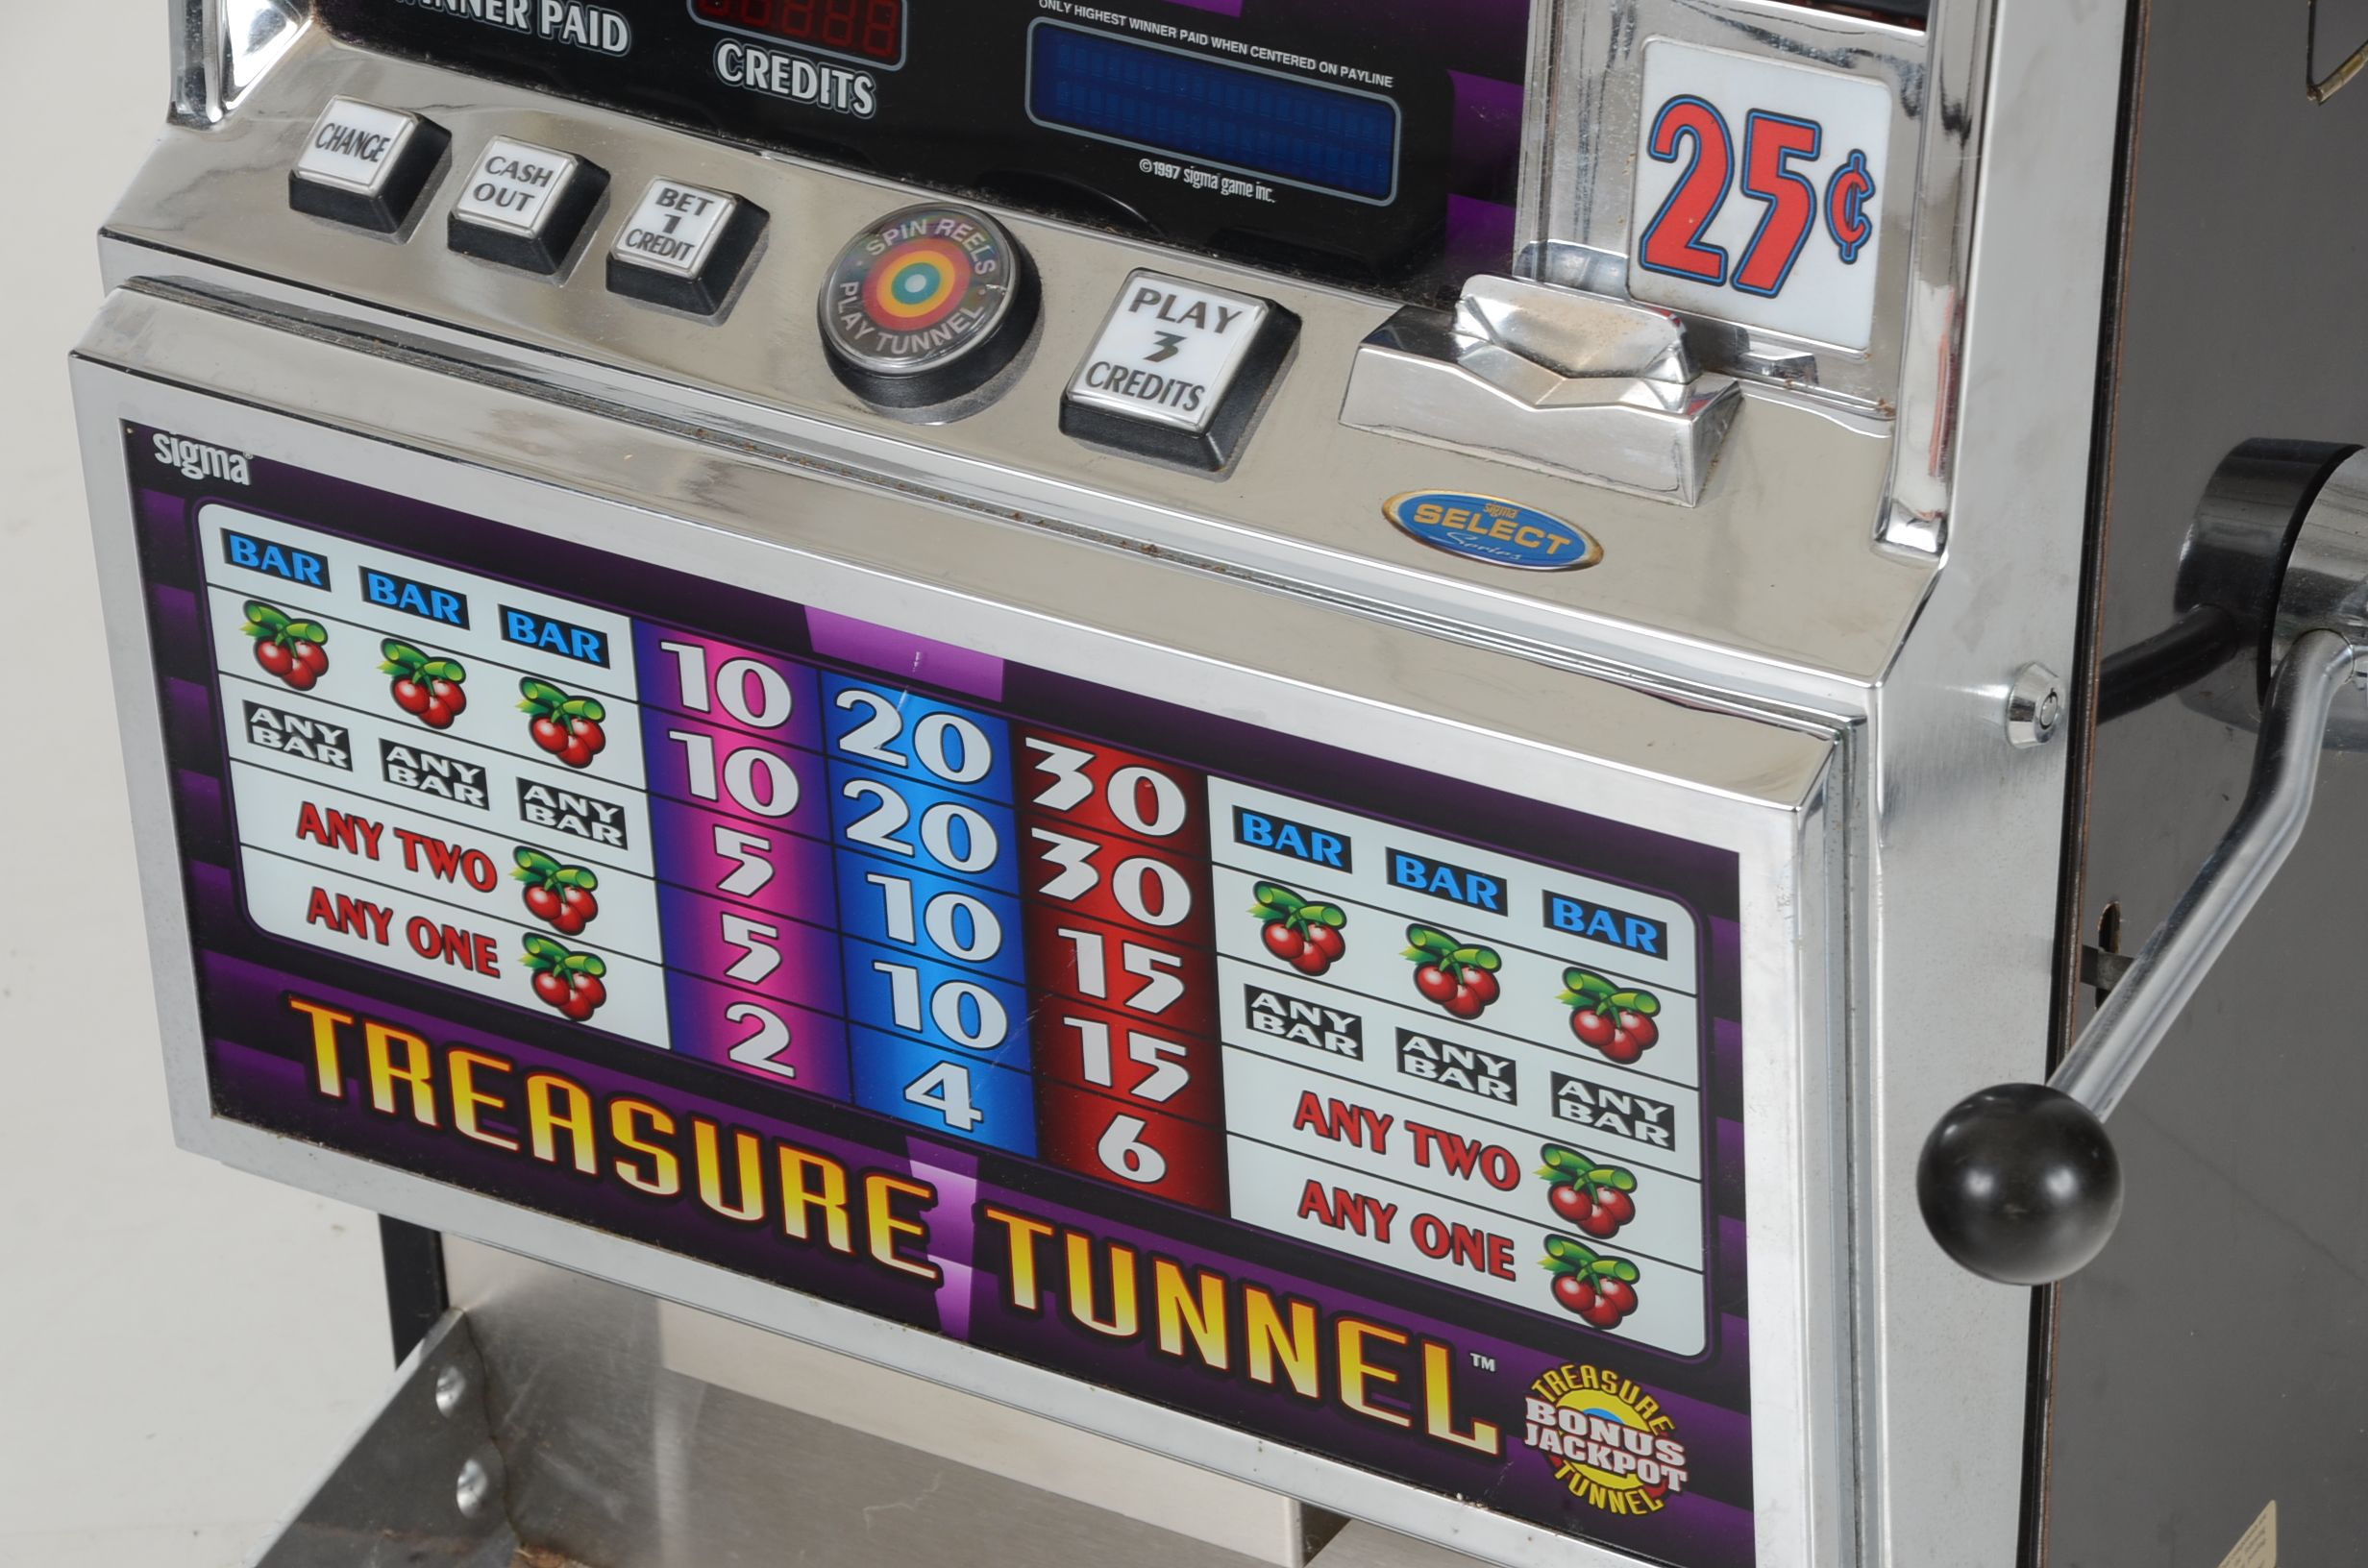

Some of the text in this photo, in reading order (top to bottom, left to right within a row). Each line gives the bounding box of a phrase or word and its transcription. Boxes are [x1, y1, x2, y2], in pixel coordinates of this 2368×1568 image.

[399, 0, 629, 52] NER PAID
[1039, 0, 1394, 88] ONLY HIGHEST WINNER PAID WHEN CENTERED ON PAYLINE
[716, 41, 874, 115] CREDITS
[314, 123, 391, 162] CHANGE
[472, 182, 536, 212] OUT
[484, 156, 554, 187] CASH
[1183, 166, 1220, 189] sigma
[1221, 176, 1253, 198] game
[1255, 182, 1276, 204] inc.
[655, 188, 714, 216] BET
[665, 213, 679, 233] 1
[625, 228, 695, 261] CREDIT
[867, 218, 996, 277] SPIN REELS
[840, 281, 985, 355] PLAY TUNNEL
[1128, 286, 1243, 334] PLAY
[1143, 330, 1185, 361] 3
[1085, 361, 1206, 412] CREDITS
[1414, 503, 1571, 554] SELECT
[1429, 531, 1521, 560] Series
[230, 534, 601, 663] BAR BAR BAR
[250, 708, 343, 746] ANY
[252, 725, 349, 769] BAR
[660, 641, 1187, 836] 10 20 30
[386, 747, 481, 784] ANY
[387, 764, 484, 807] BAR
[523, 785, 619, 823] ANY
[525, 802, 623, 846] BAR
[668, 729, 1192, 927] 10 20 30
[297, 801, 498, 893] ANY TWO
[1242, 812, 1658, 954] BAR BAR BAR
[307, 887, 500, 978] ANY ONE
[714, 825, 1185, 1014] 5 10 15
[721, 912, 1190, 1103] 5 10 15
[1250, 992, 1356, 1034] ANY
[1252, 1010, 1359, 1058] BAR
[1402, 1036, 1510, 1077] ANY
[725, 1002, 1167, 1184] 2 4 6
[1403, 1054, 1513, 1103] BAR
[1557, 1080, 1668, 1122] ANY
[1294, 1090, 1521, 1191] ANY TWO
[1558, 1098, 1670, 1148] BAR
[289, 996, 939, 1281] TREASURE
[984, 1206, 1499, 1456] TUNNEL
[1297, 1179, 1516, 1281] ANY ONE
[1531, 1364, 1676, 1436] TREASURE
[1524, 1397, 1686, 1467] BONUS
[1524, 1422, 1689, 1492] JACKPOT
[1554, 1459, 1665, 1515] TUNNEL
